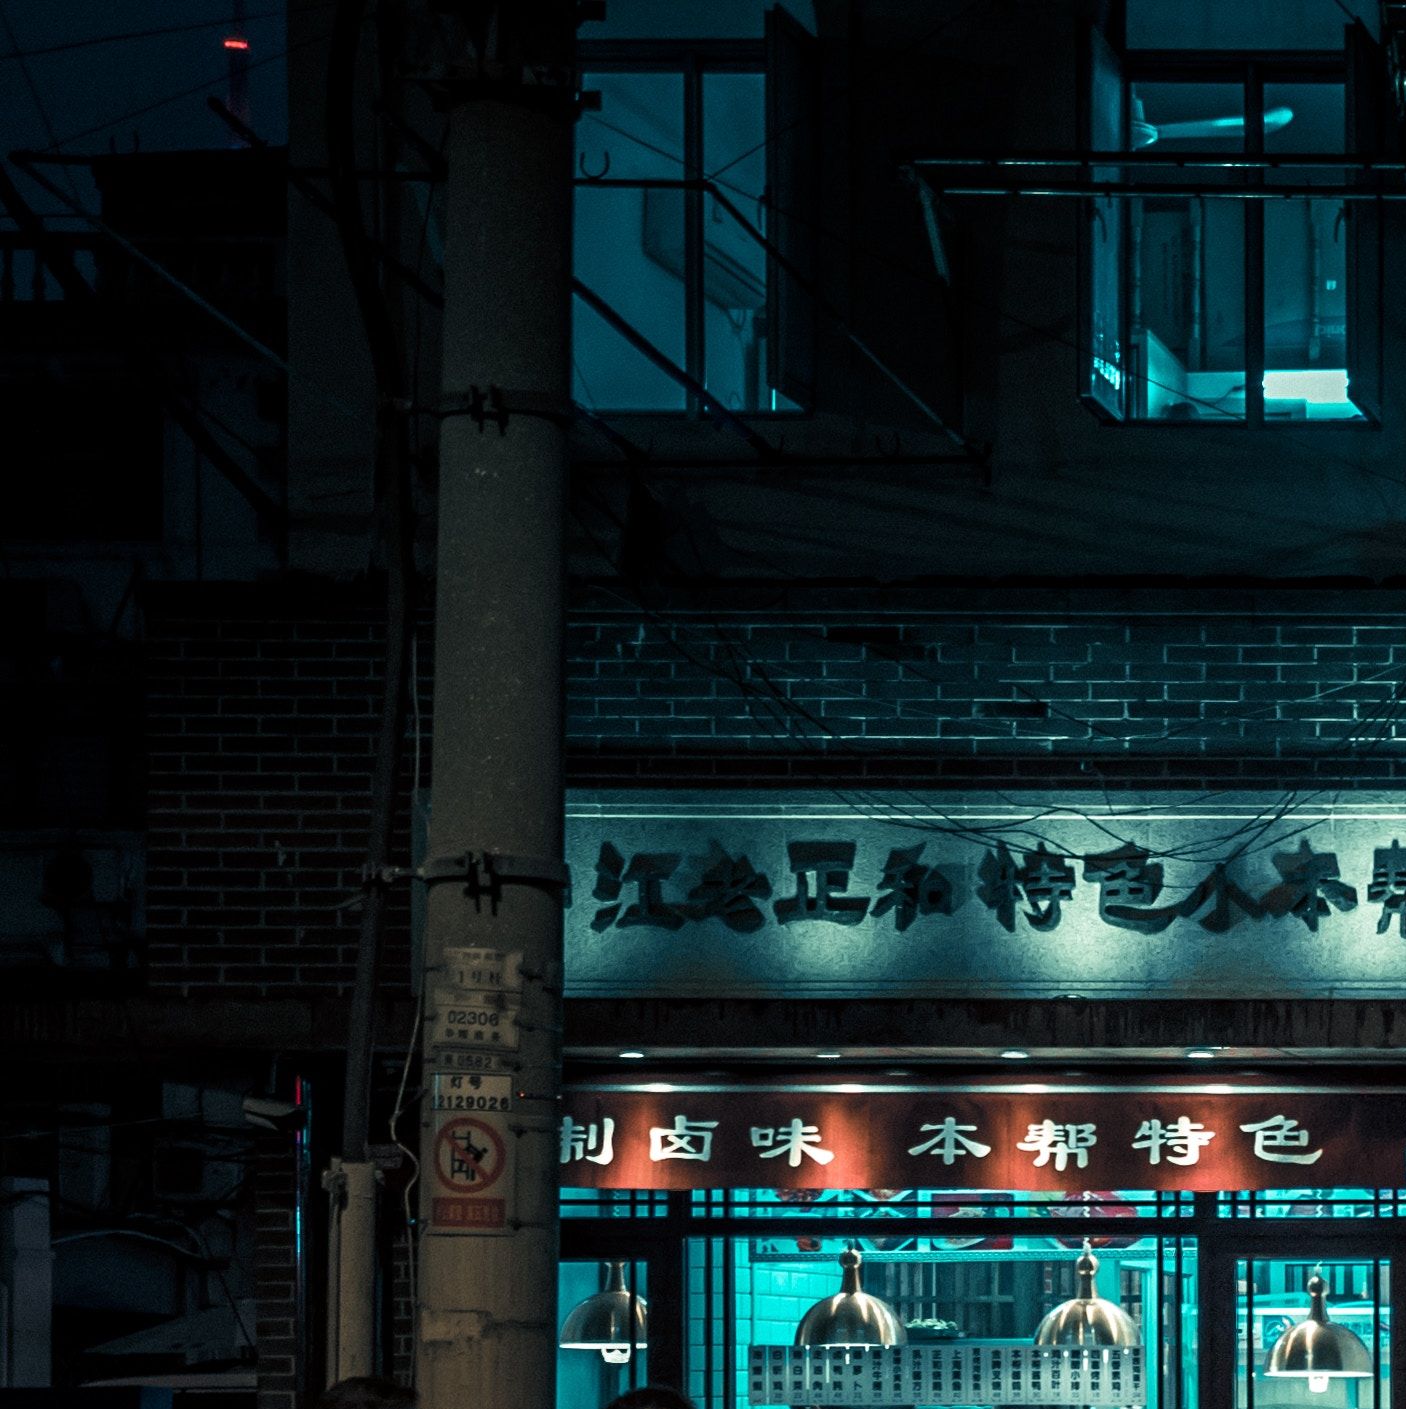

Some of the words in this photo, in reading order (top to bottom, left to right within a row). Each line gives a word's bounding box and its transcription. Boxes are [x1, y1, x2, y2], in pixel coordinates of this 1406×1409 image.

[559, 1114, 836, 1168] 制卤味
[907, 1114, 1323, 1172] 本帮特色
